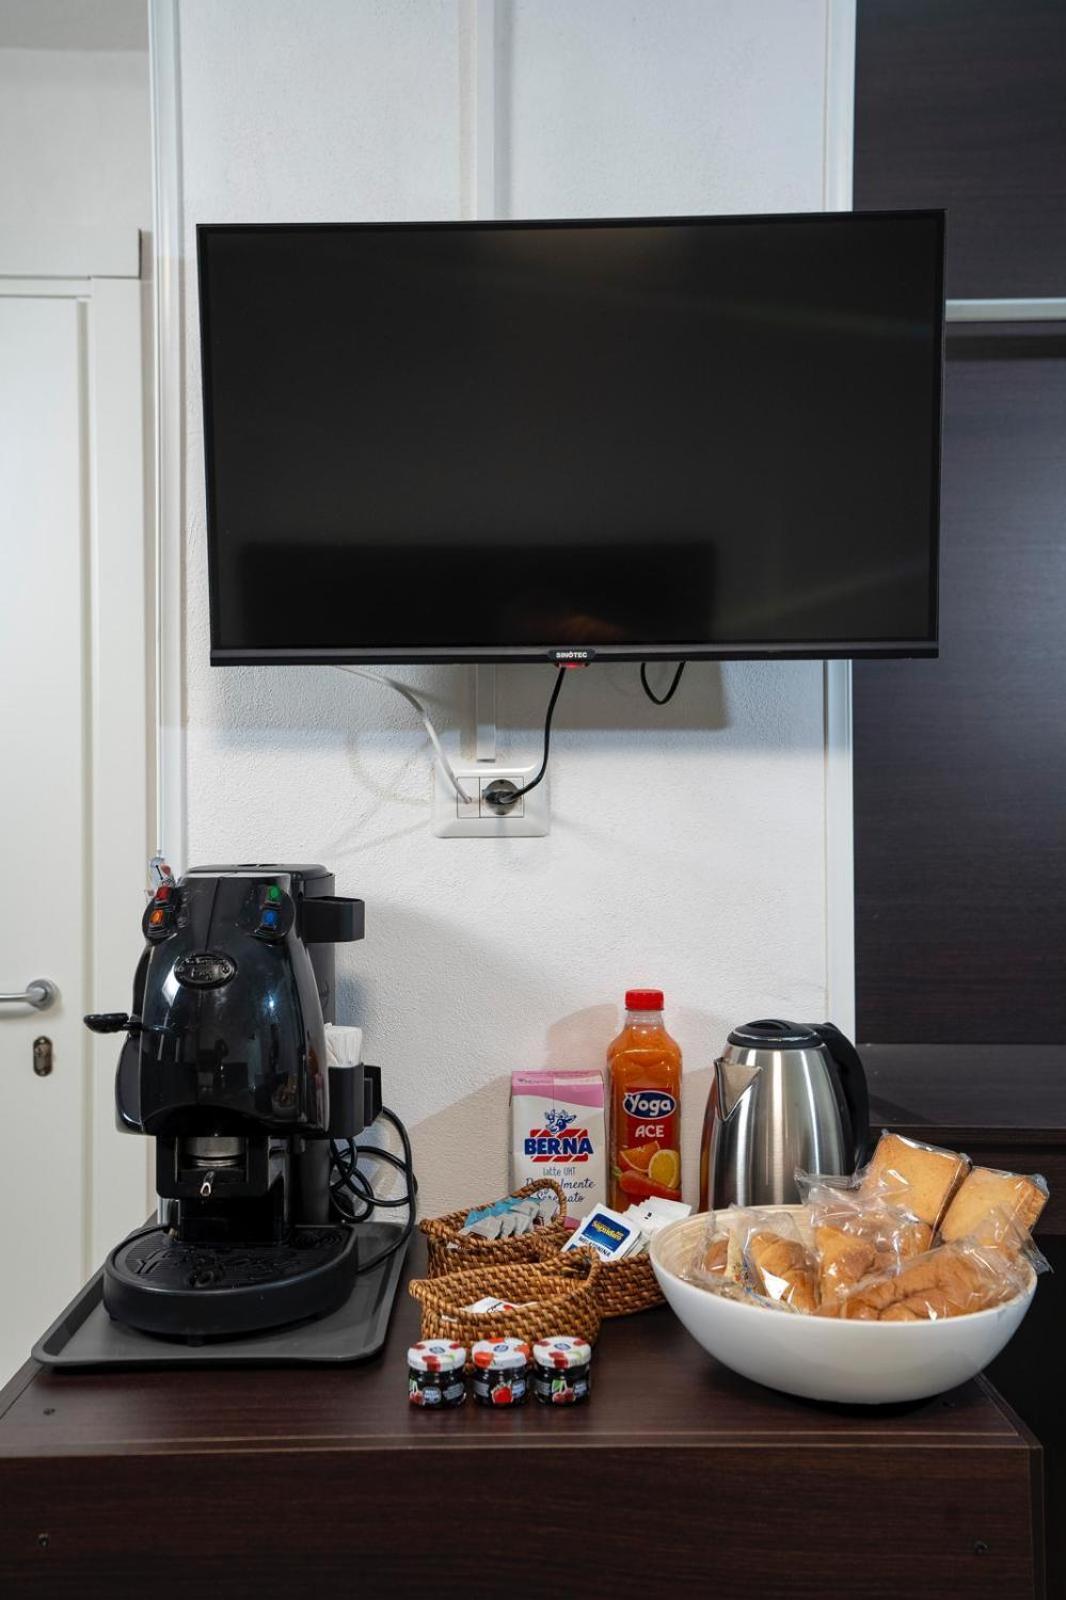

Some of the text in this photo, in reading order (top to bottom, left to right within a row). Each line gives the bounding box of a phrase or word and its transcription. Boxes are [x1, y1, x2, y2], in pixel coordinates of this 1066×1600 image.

[556, 651, 588, 659] SINOTEC
[627, 1094, 672, 1117] Yoga
[634, 1125, 665, 1138] ACE
[524, 1137, 594, 1155] BERNA
